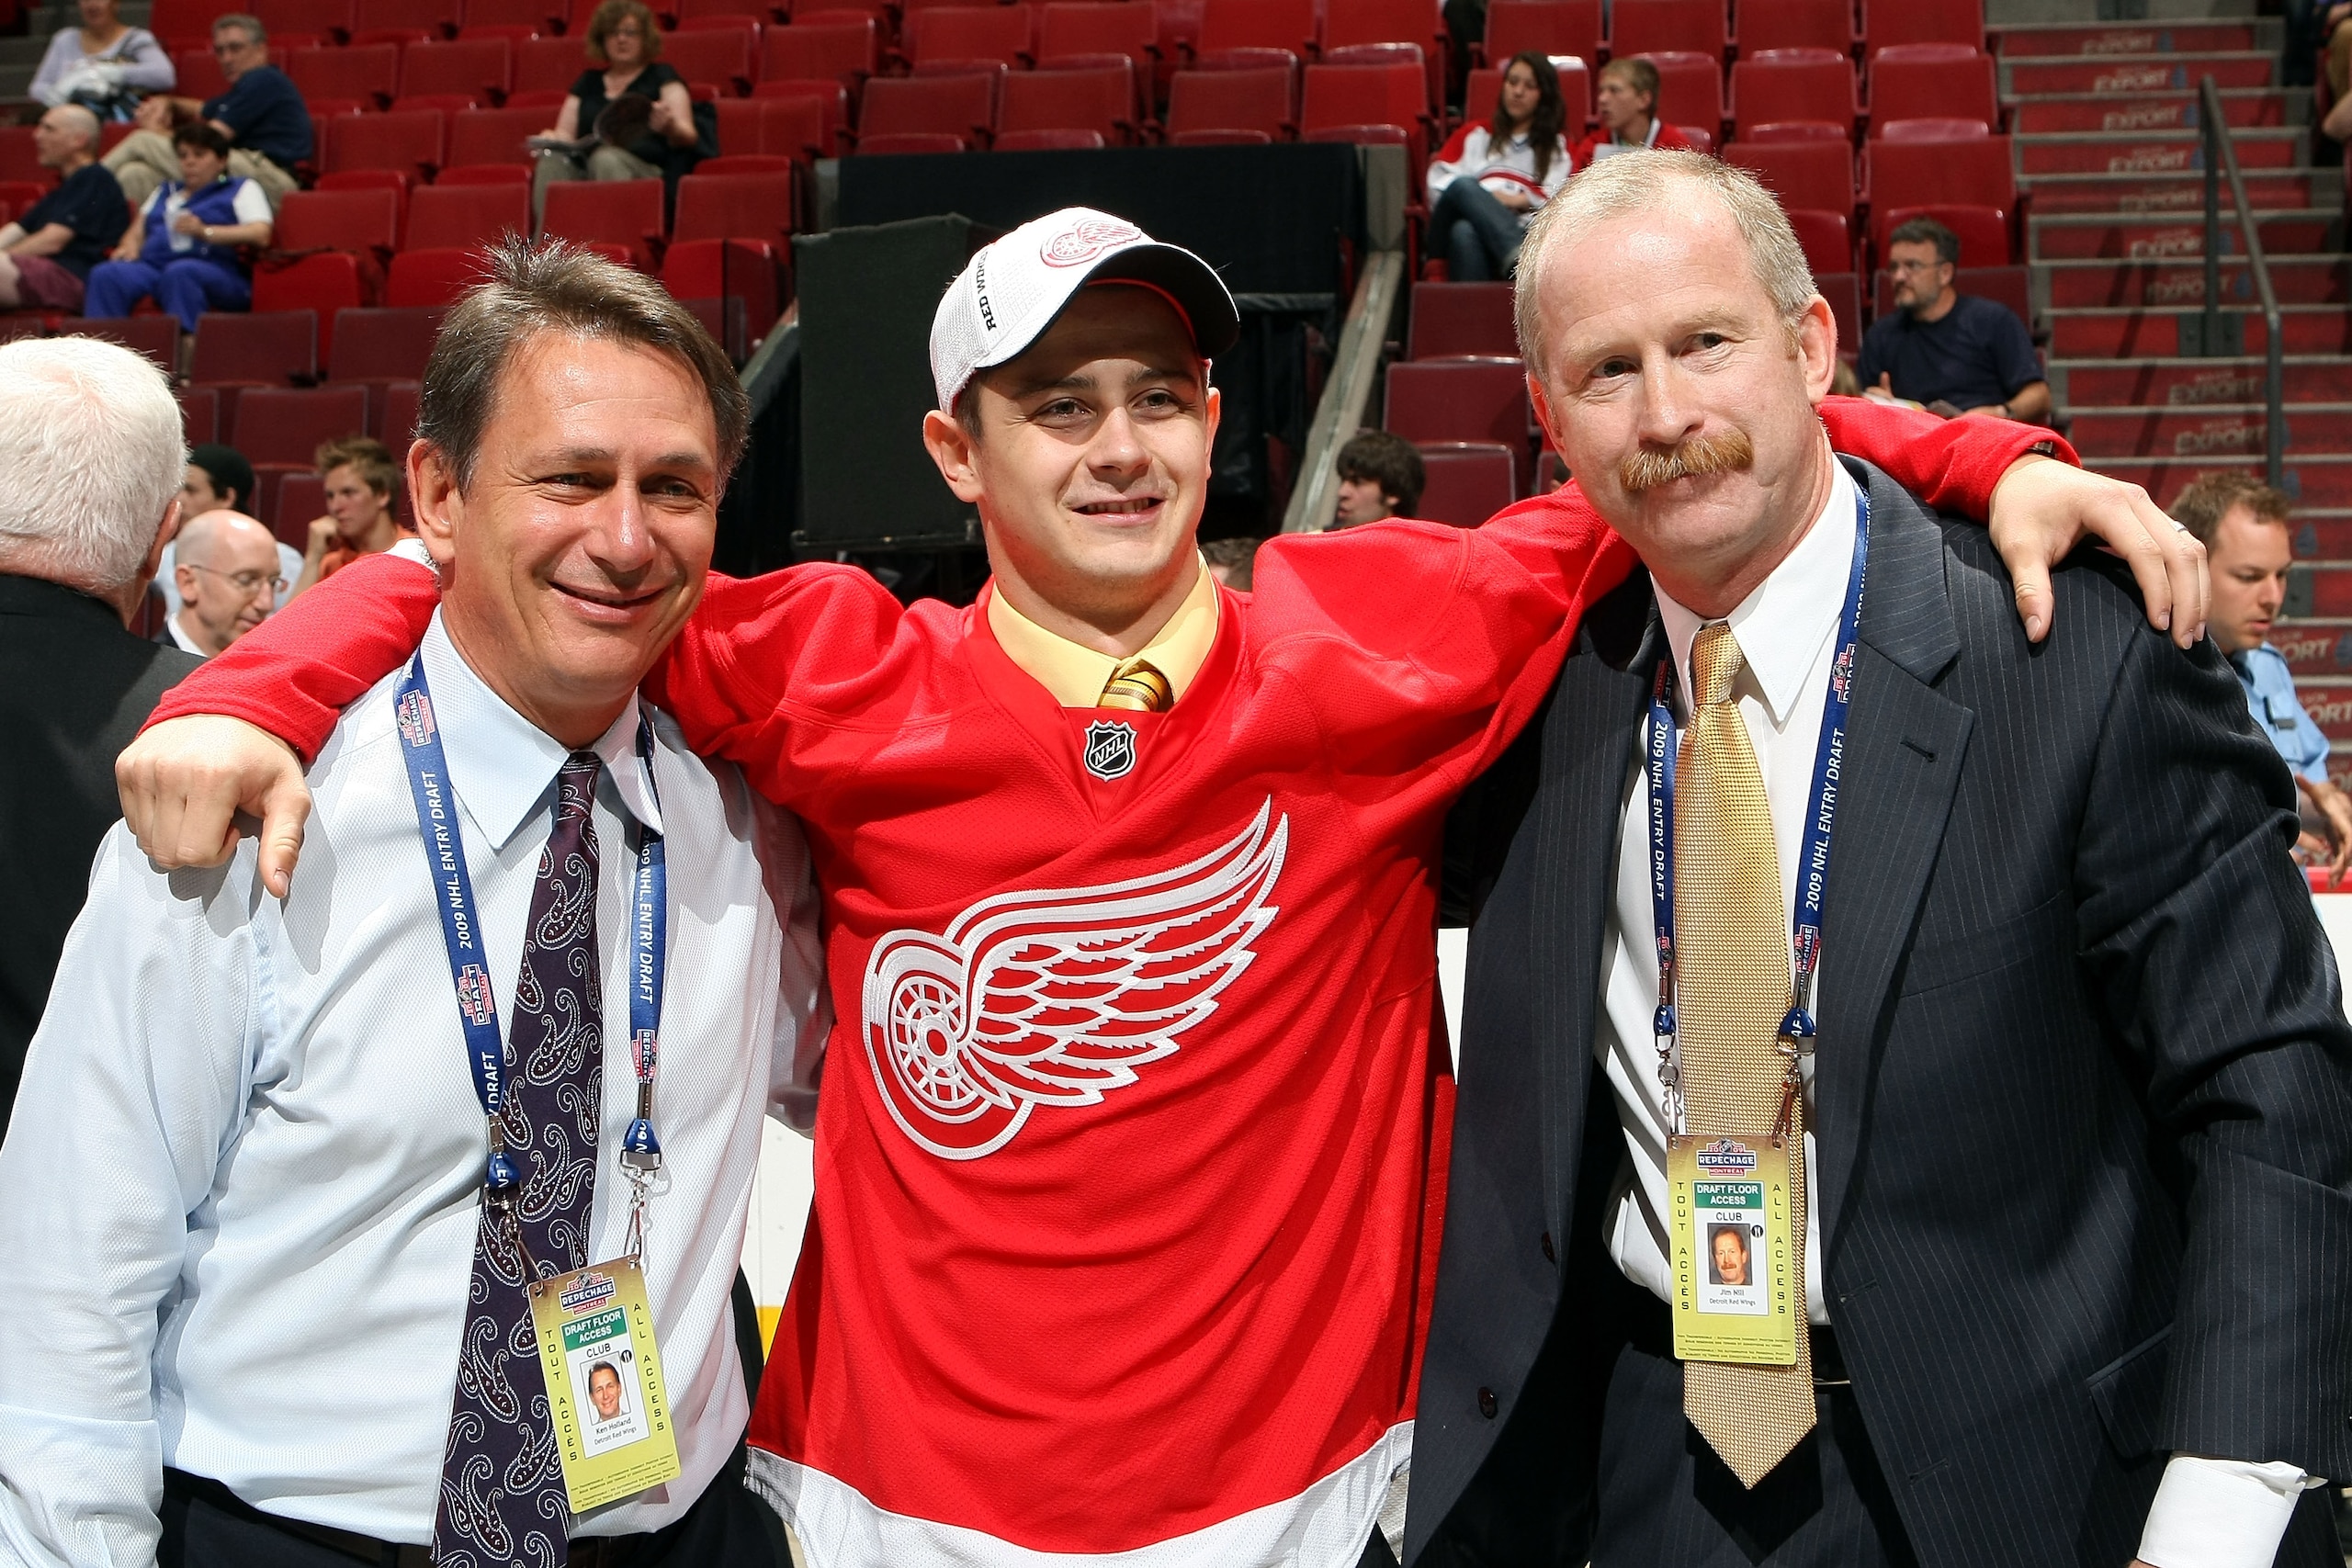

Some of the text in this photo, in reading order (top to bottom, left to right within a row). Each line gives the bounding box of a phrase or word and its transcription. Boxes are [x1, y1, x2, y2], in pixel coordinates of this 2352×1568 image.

[2131, 236, 2203, 258] EXPOR
[979, 296, 997, 332] RED
[1094, 737, 1125, 766] NHL
[1653, 722, 1668, 758] 2009
[422, 771, 445, 820] DRAFT
[1653, 799, 1666, 847] ENTRY
[1805, 873, 1823, 911] 2009
[1817, 775, 1838, 835] ENTRY
[1828, 728, 1845, 782] DRAFT
[434, 823, 457, 871] ENTRY
[1655, 851, 1666, 901] DRAFT
[458, 911, 472, 950] 2009
[639, 903, 653, 953] ENTRY
[468, 966, 486, 1023] DRAFT
[639, 953, 653, 1004] DRAFT
[481, 1051, 500, 1105] DRAFT
[1677, 1182, 1686, 1232] TOUT
[1697, 1184, 1758, 1194] DRAFT FLOOR
[1710, 1195, 1746, 1205] ACCESS
[1772, 1183, 1782, 1220] ALL
[1715, 1212, 1743, 1222] CLUB
[1774, 1235, 1786, 1314] ACCESS
[564, 1311, 622, 1337] DRAFT FLOOR
[579, 1325, 613, 1344] ACCESS
[633, 1303, 646, 1339] ALL
[545, 1329, 561, 1381] TOUT
[586, 1343, 611, 1359] CLUB
[643, 1354, 665, 1431] ACCESS
[595, 1416, 632, 1435] Ken Holland
